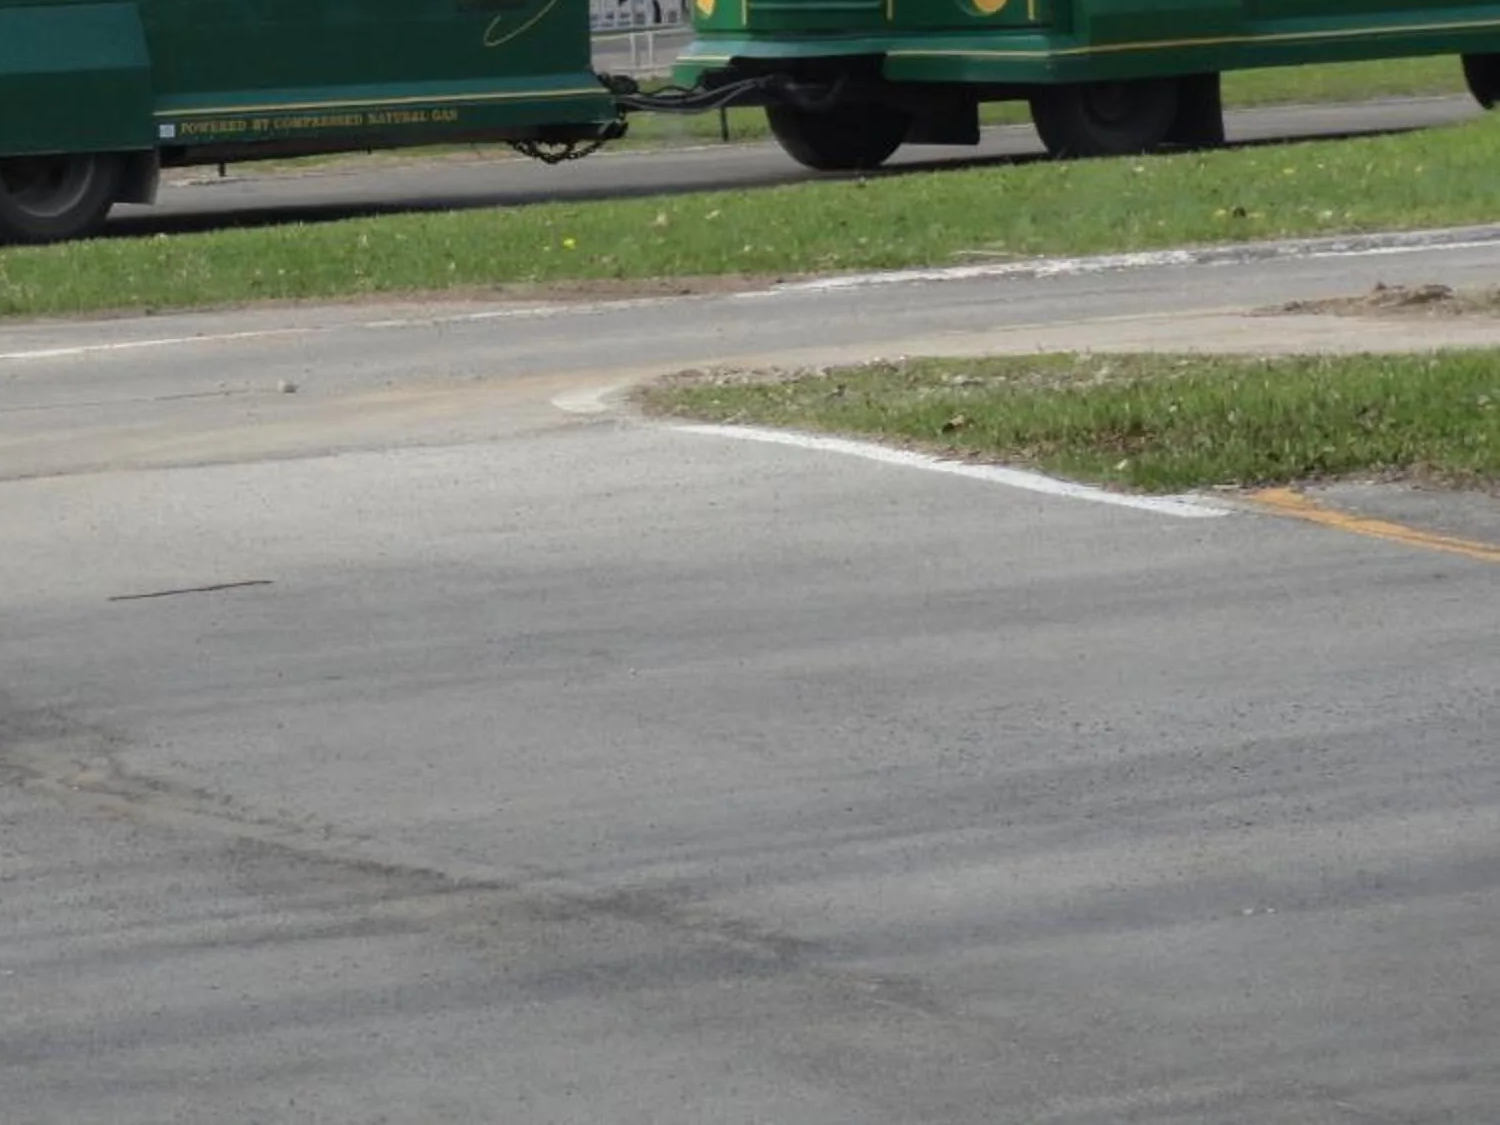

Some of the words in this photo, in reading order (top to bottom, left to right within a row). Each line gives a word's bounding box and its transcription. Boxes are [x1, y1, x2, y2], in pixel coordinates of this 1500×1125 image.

[181, 119, 247, 136] POWERED
[273, 115, 364, 131] COMPRESSED
[367, 111, 428, 126] NATURAL
[431, 109, 458, 123] GAS
